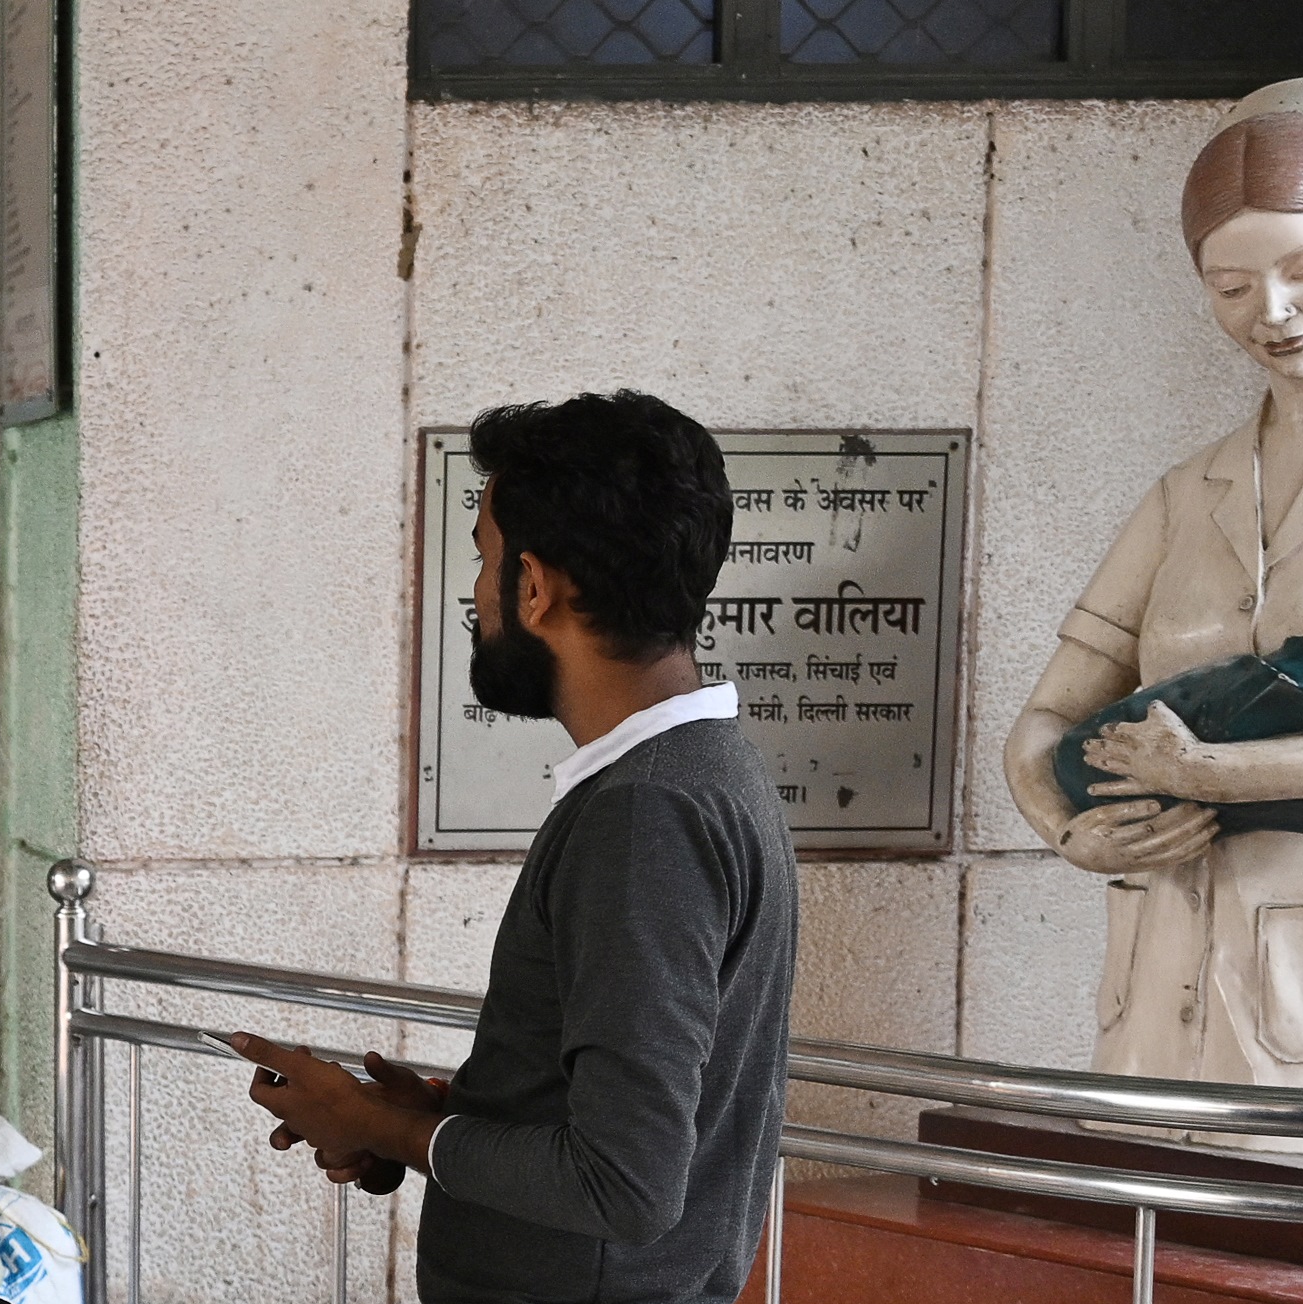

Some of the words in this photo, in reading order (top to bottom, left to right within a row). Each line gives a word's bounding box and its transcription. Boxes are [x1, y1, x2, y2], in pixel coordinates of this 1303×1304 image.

[731, 489, 774, 513] वस
[782, 479, 808, 512] के
[816, 488, 891, 513] अवसर
[897, 489, 929, 513] पर
[791, 581, 926, 635] वालिया
[806, 654, 861, 685] सिंचाई
[868, 655, 898, 685] एवं
[798, 695, 847, 722] दिल्ली
[855, 703, 914, 723] सरकार
